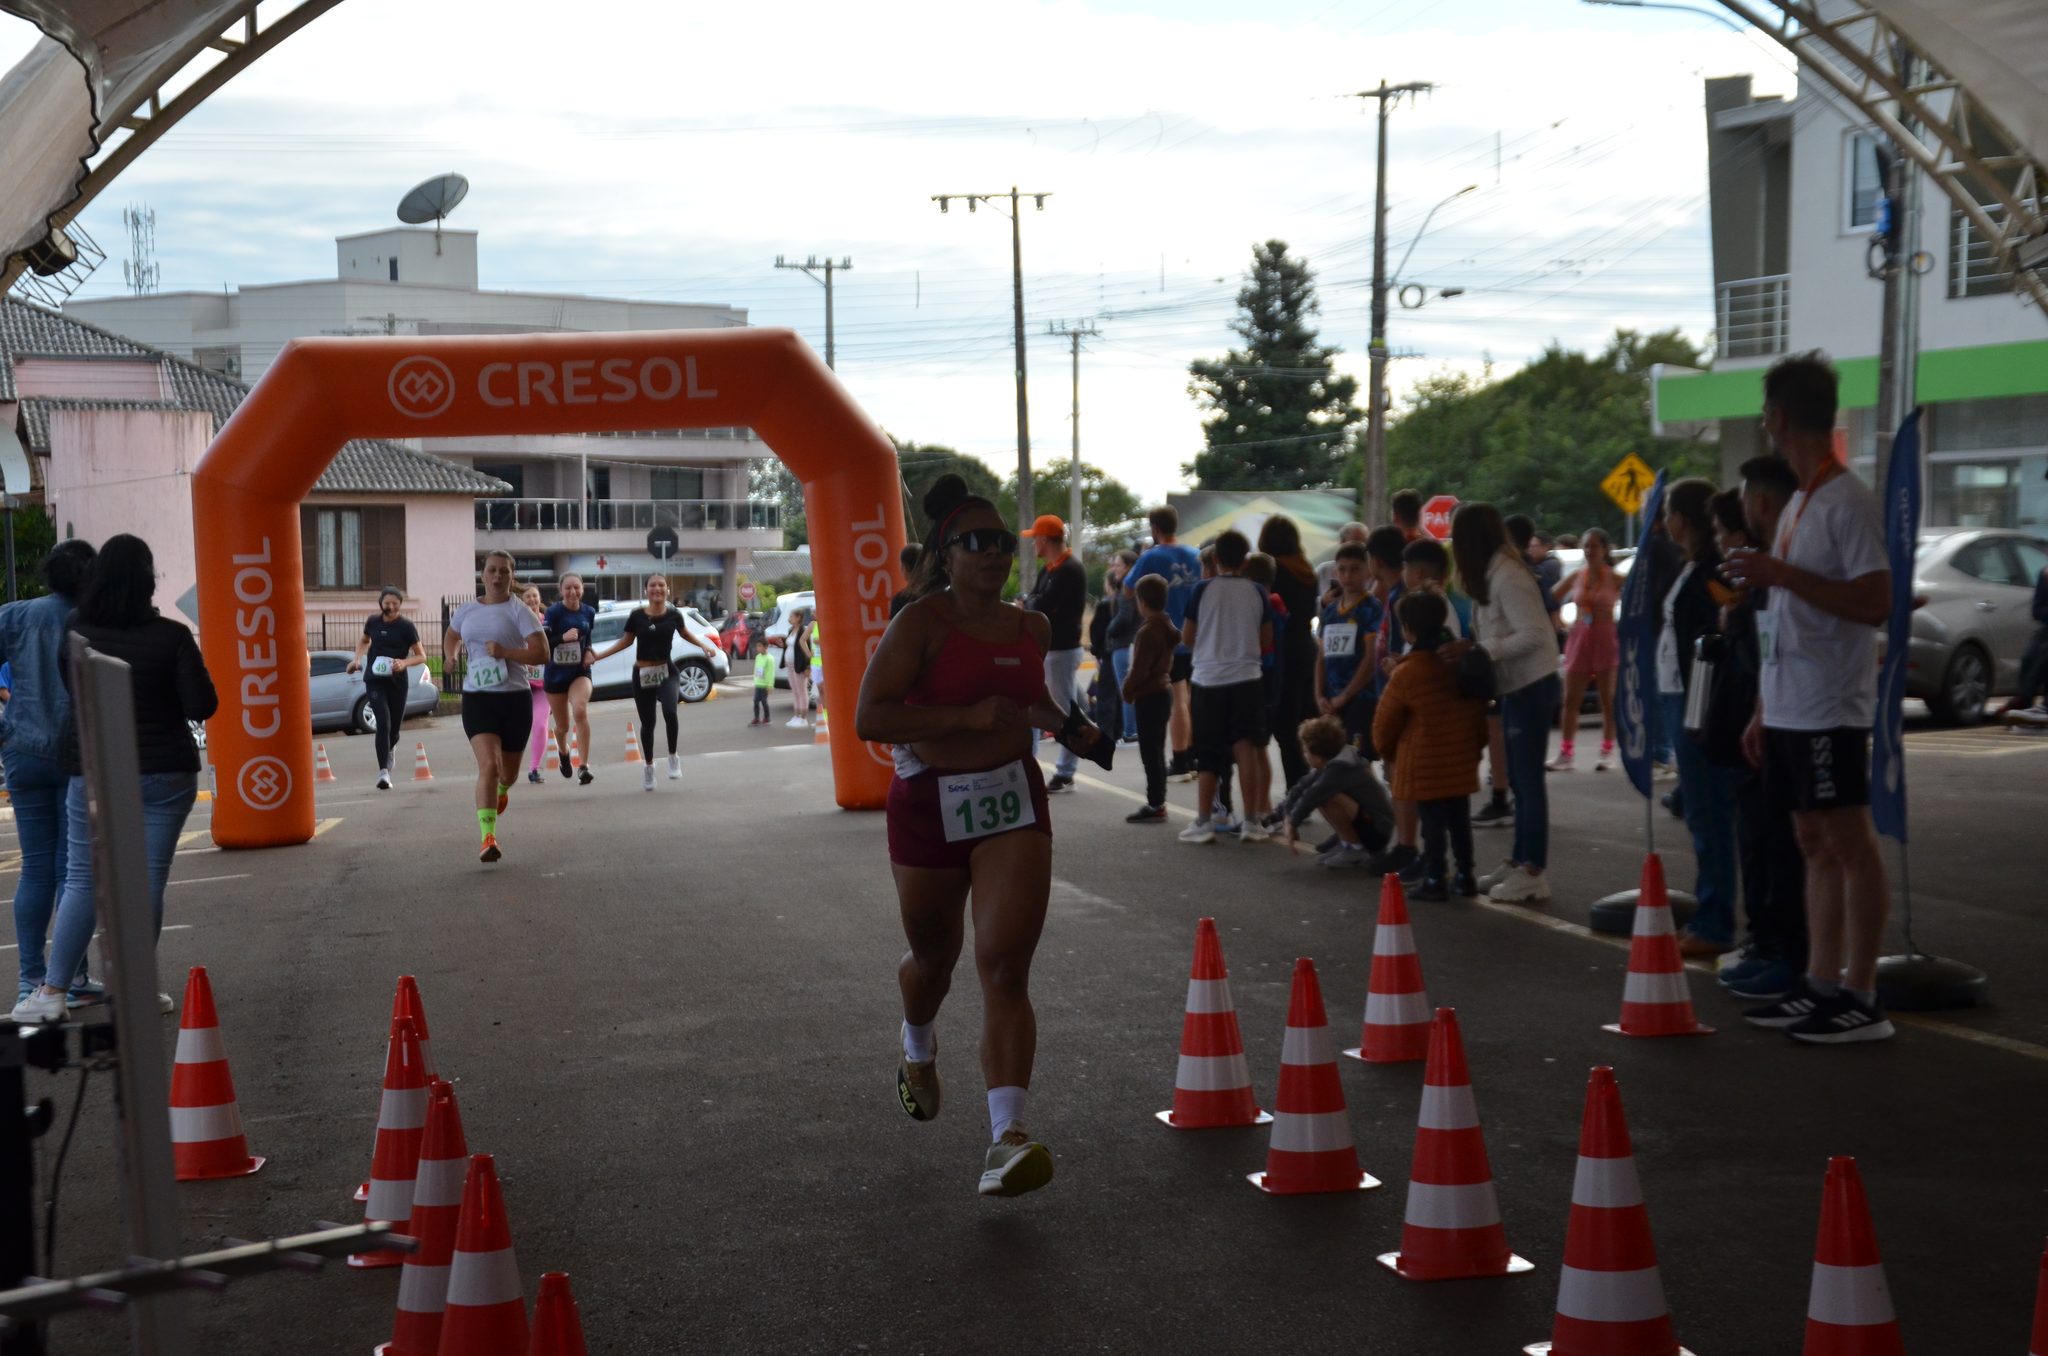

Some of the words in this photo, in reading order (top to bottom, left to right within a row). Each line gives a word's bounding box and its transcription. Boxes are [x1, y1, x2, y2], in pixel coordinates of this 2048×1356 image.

[477, 355, 719, 407] CRESOL
[232, 535, 281, 738] CRESOL
[375, 663, 387, 674] 49
[556, 650, 578, 662] 375
[474, 666, 502, 687] 121
[644, 670, 665, 685] 240
[956, 790, 1021, 833] 139
[899, 1082, 915, 1113] FILA
